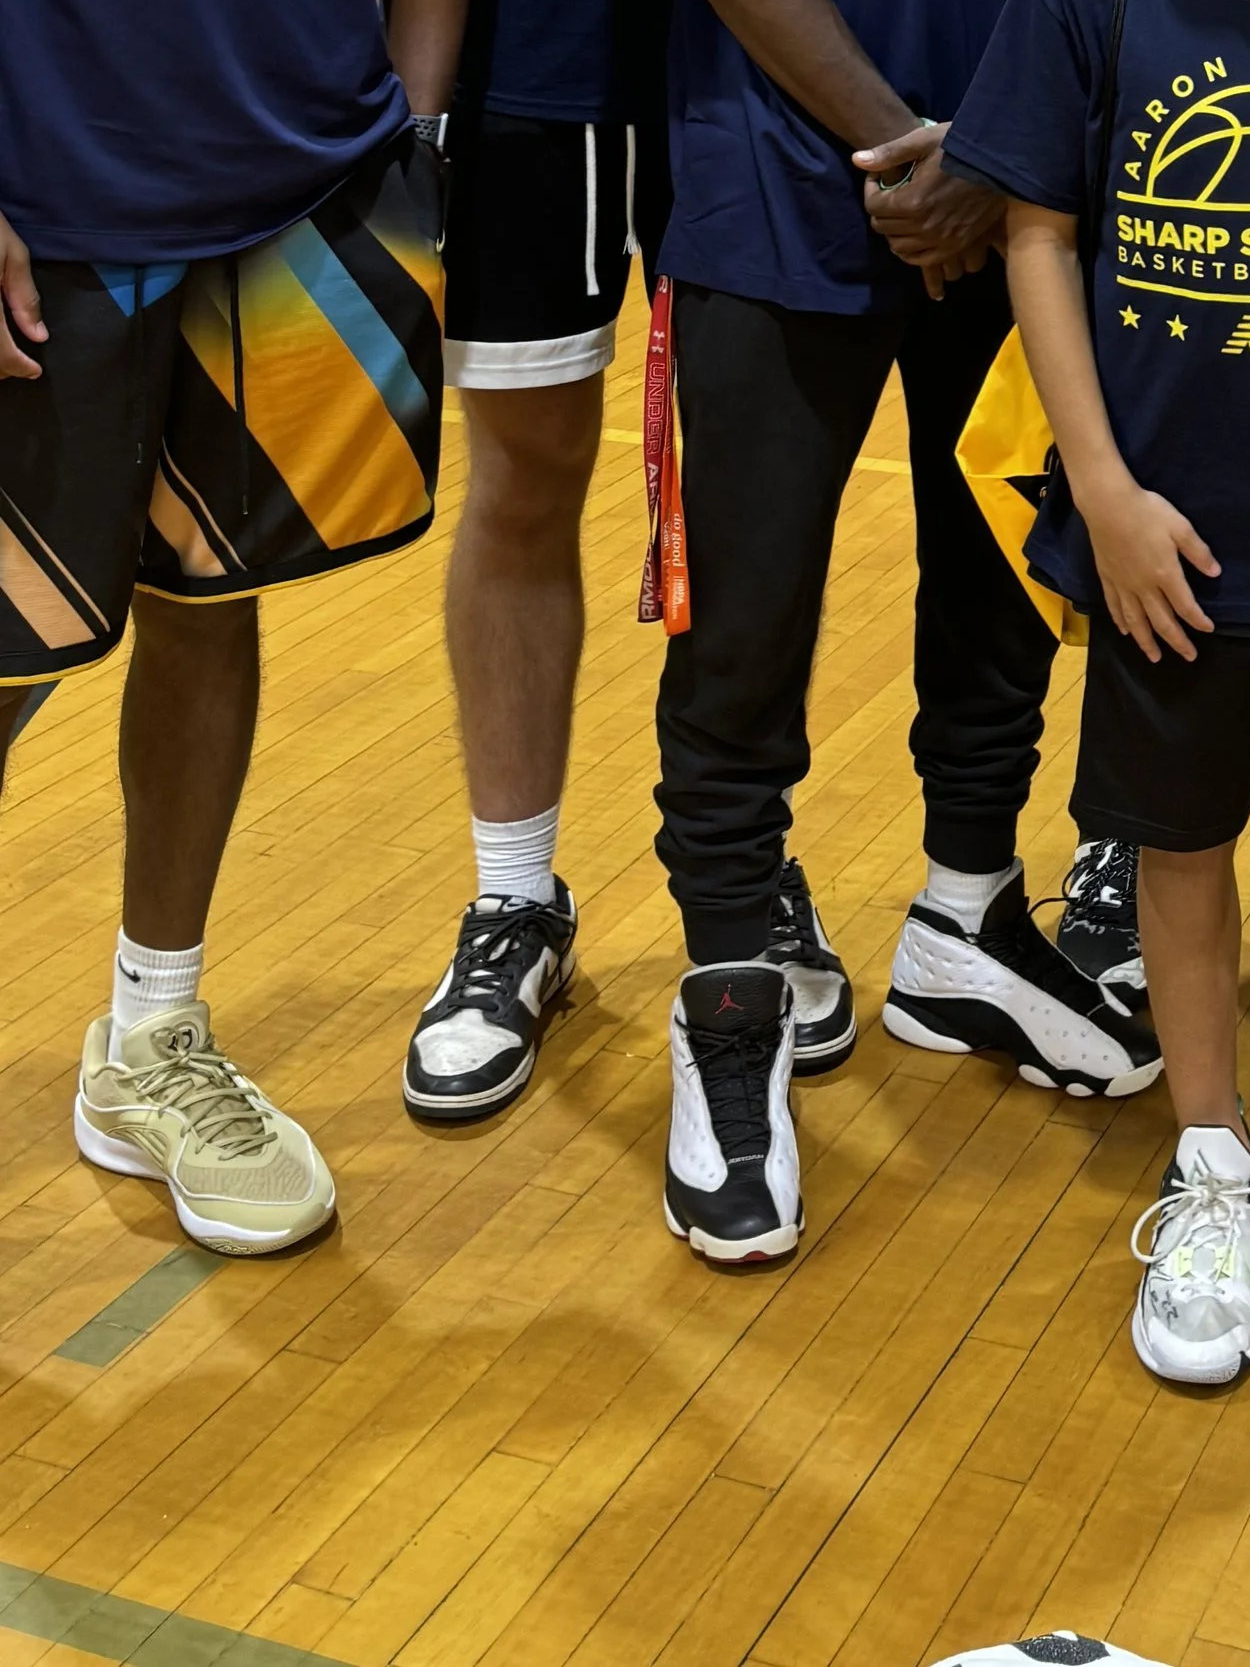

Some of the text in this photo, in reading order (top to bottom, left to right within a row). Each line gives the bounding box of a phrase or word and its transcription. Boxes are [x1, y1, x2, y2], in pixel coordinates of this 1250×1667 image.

[1124, 57, 1227, 180] AARON
[1117, 215, 1229, 254] SHARP
[647, 362, 665, 454] UNDER
[674, 513, 683, 530] do
[672, 532, 685, 567] good
